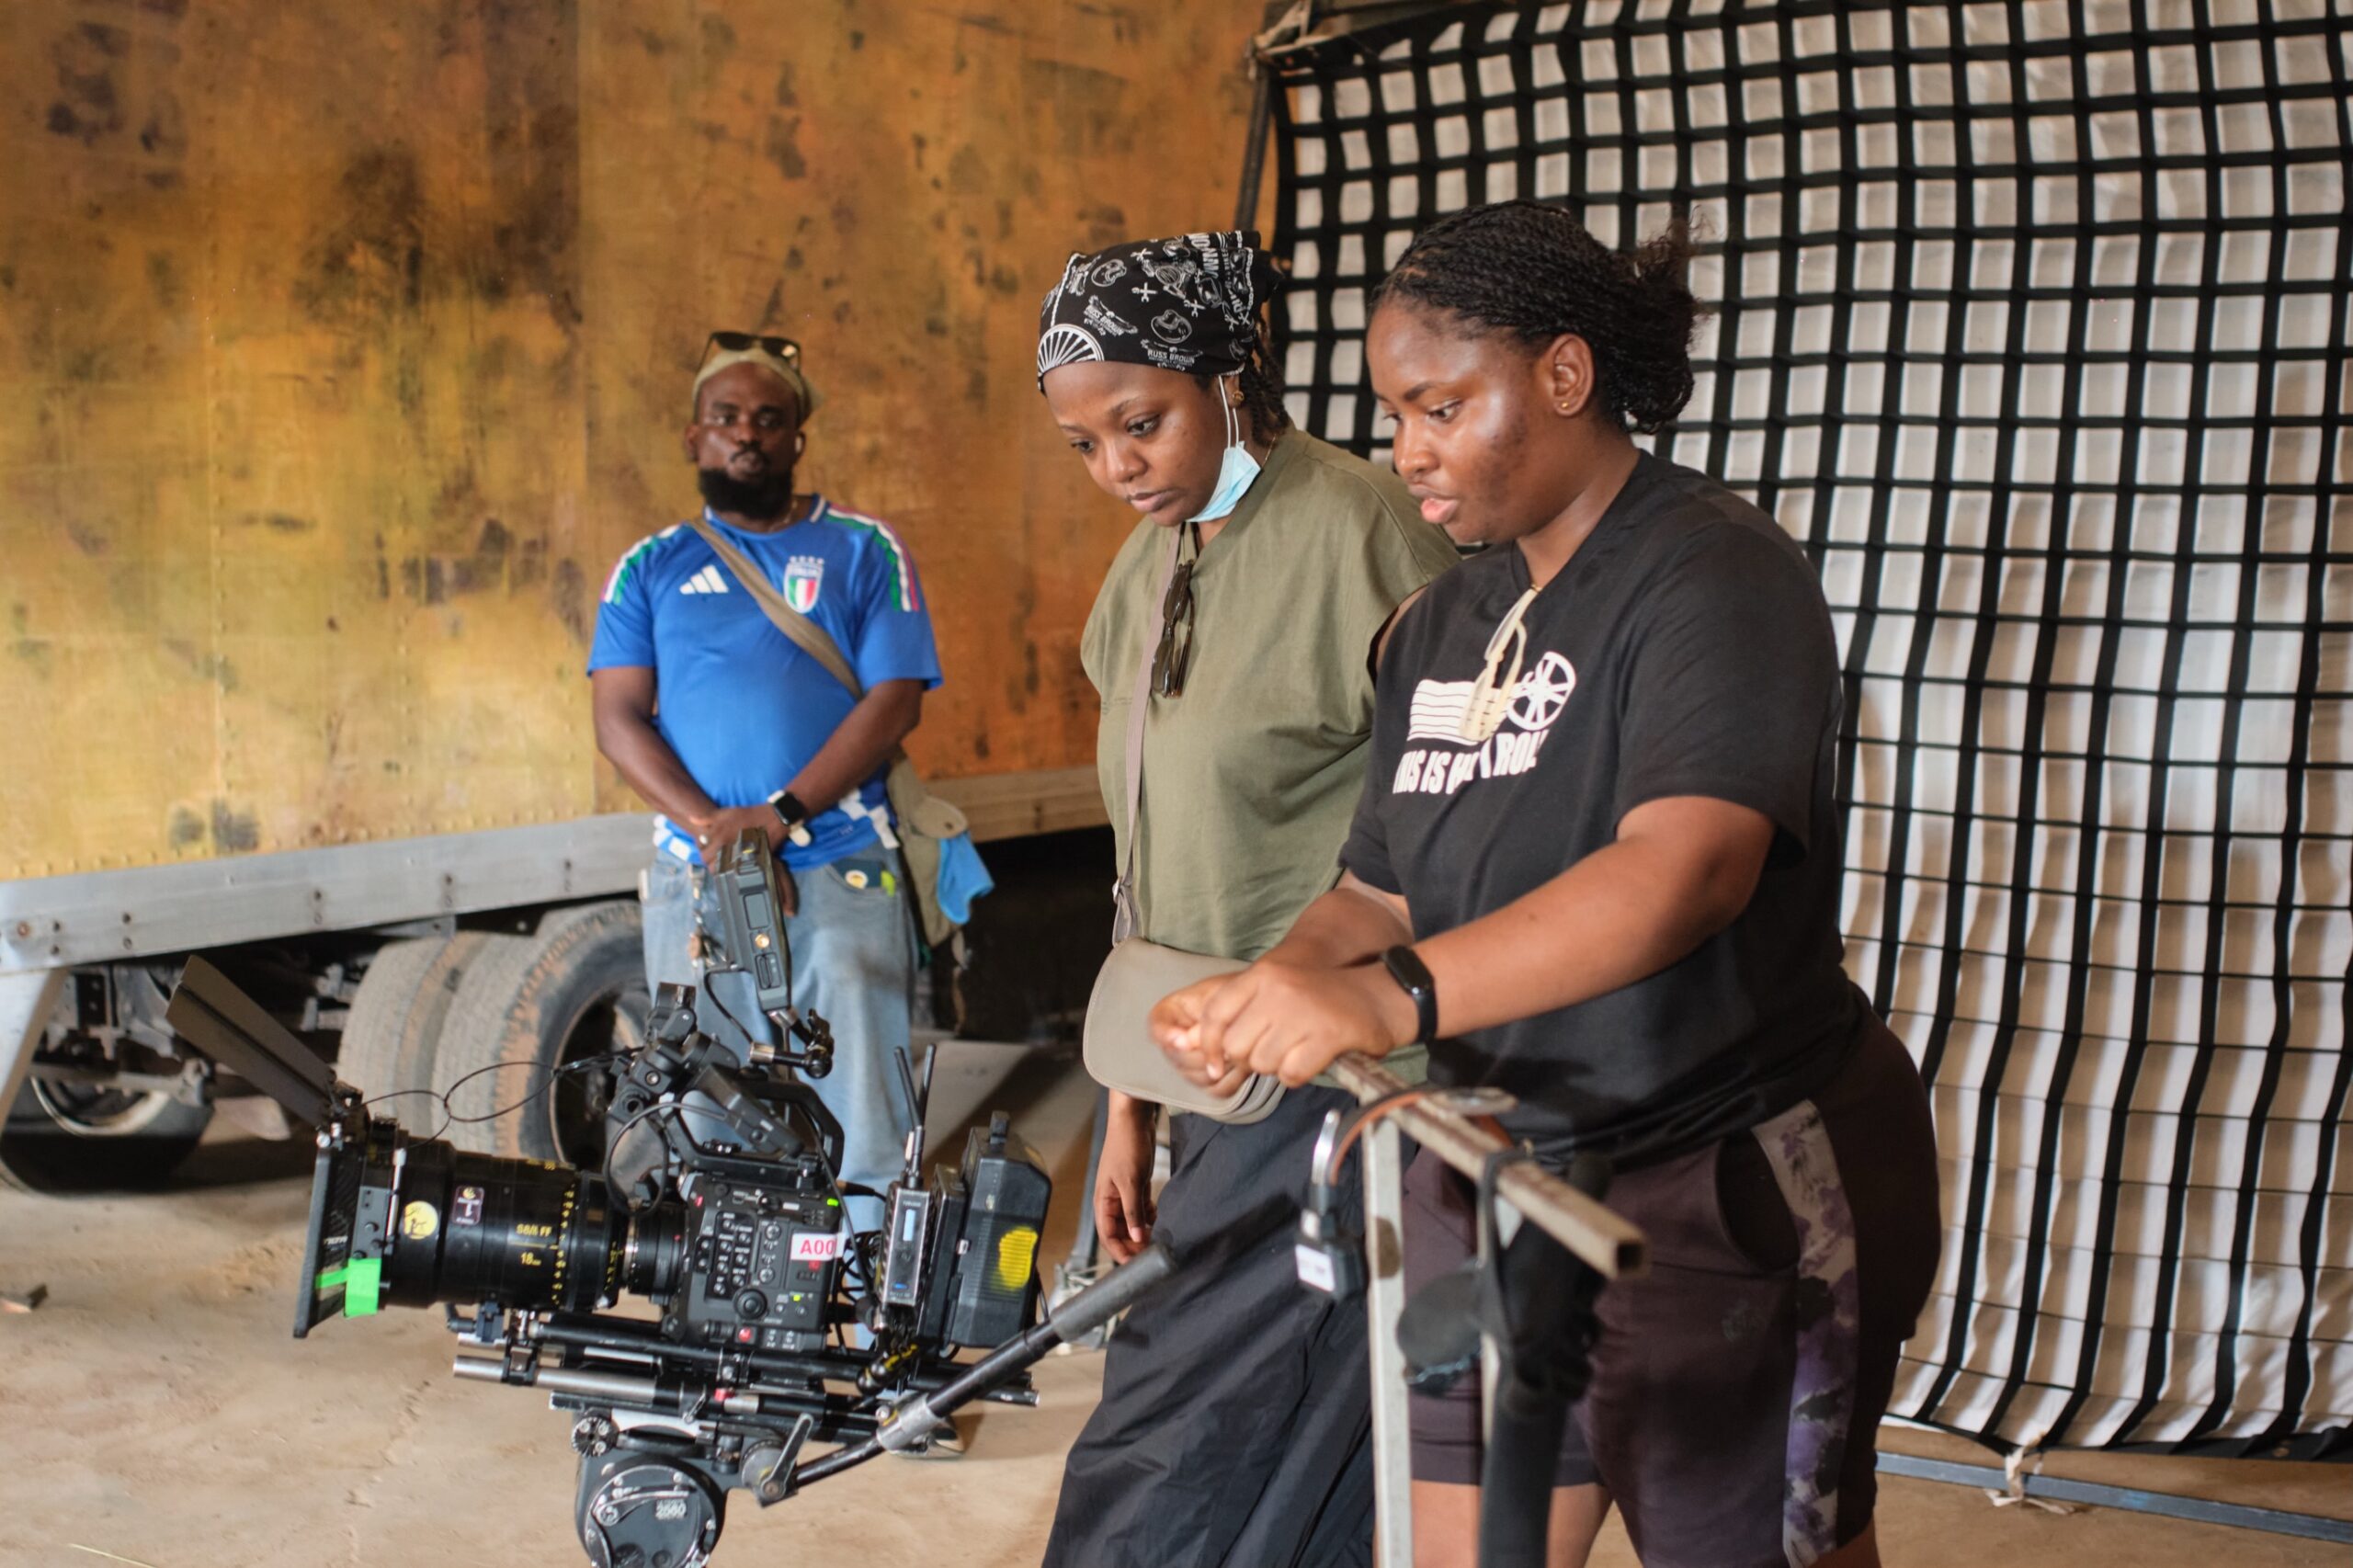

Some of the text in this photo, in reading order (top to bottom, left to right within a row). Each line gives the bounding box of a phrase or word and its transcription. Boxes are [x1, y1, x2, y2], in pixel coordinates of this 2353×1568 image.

[1147, 348, 1168, 359] RUSS
[1168, 351, 1195, 364] BROWN
[1419, 750, 1451, 795] IS
